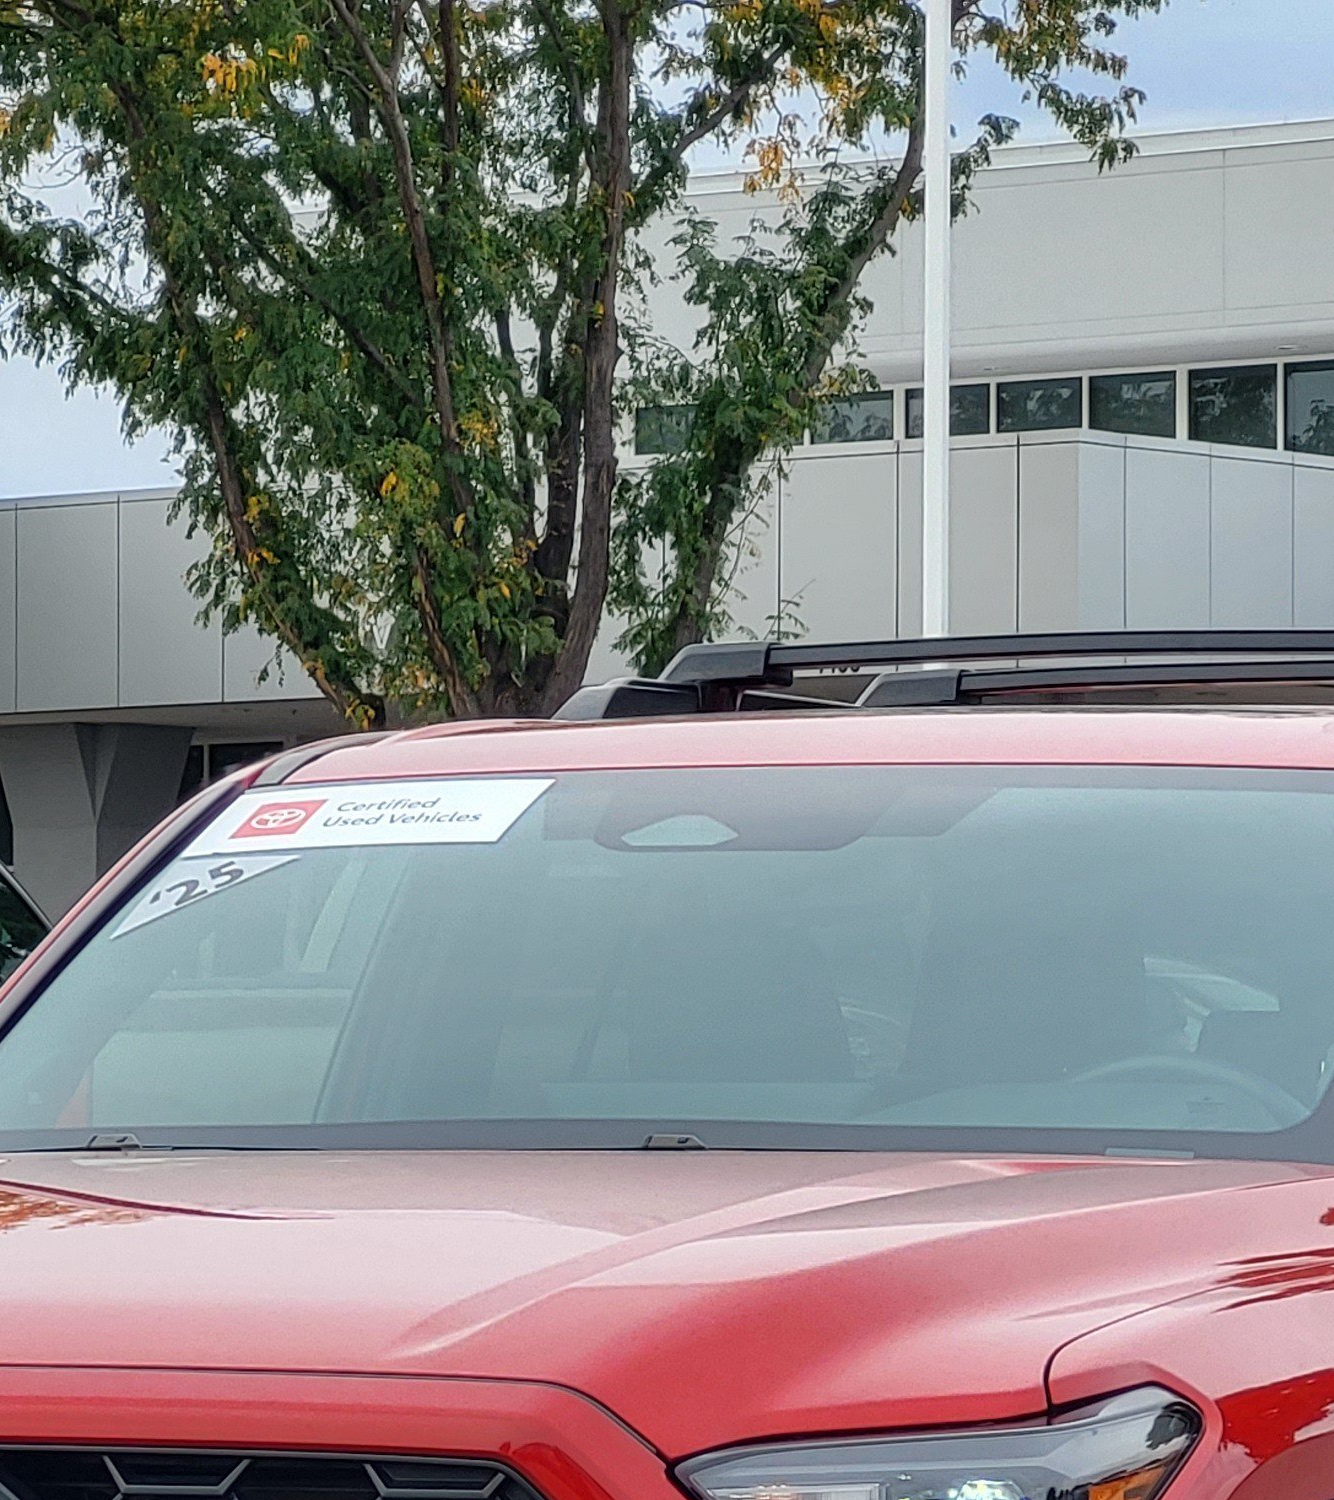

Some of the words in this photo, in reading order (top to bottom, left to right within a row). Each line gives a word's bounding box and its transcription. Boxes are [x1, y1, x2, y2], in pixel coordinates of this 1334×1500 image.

[336, 797, 441, 812] Certified
[322, 813, 382, 827] Used
[387, 811, 483, 825] Vehicles
